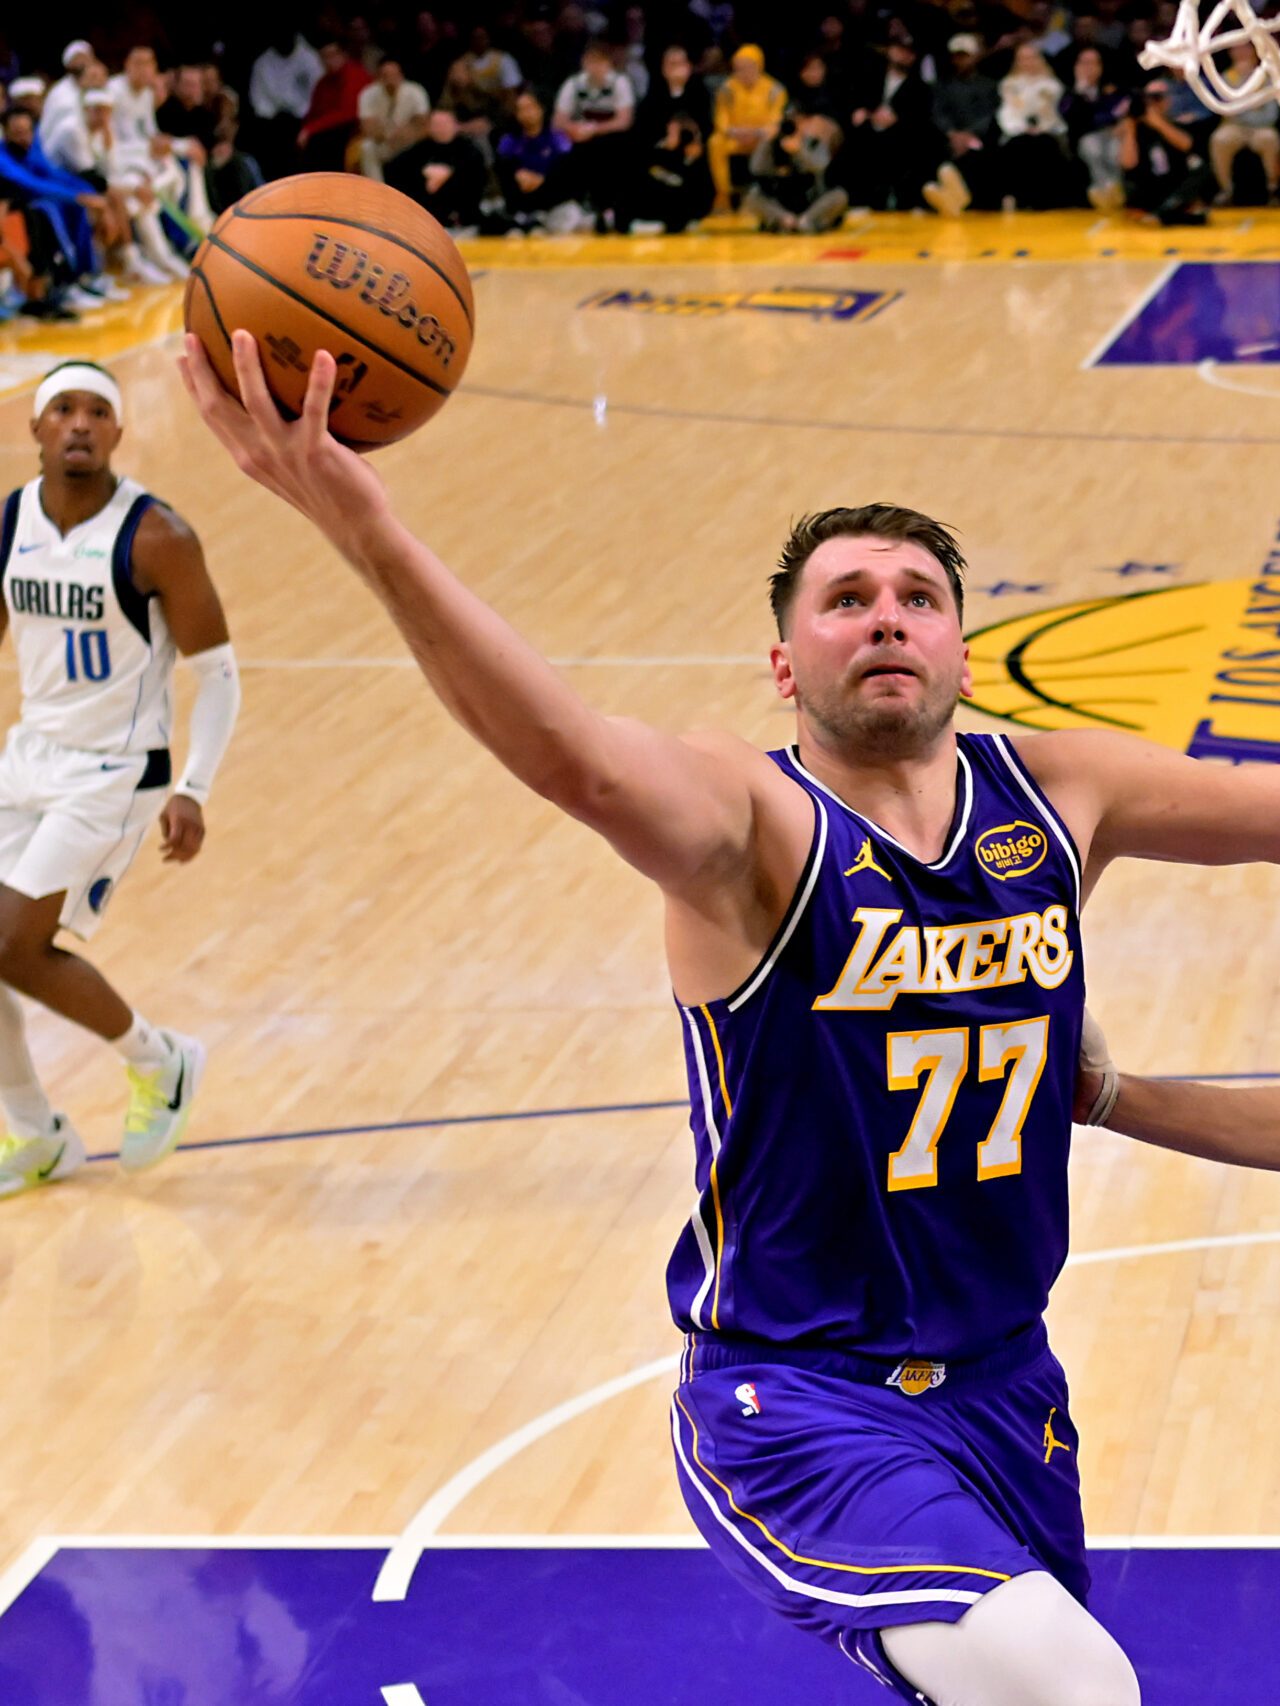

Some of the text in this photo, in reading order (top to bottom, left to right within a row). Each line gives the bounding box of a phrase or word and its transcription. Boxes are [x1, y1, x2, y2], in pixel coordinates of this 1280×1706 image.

[305, 232, 457, 369] Wilson
[10, 577, 105, 622] DALLAS
[62, 627, 112, 683] 10
[979, 834, 1042, 863] bibigo
[811, 904, 1075, 1011] LAKERS
[886, 1014, 1050, 1192] 77
